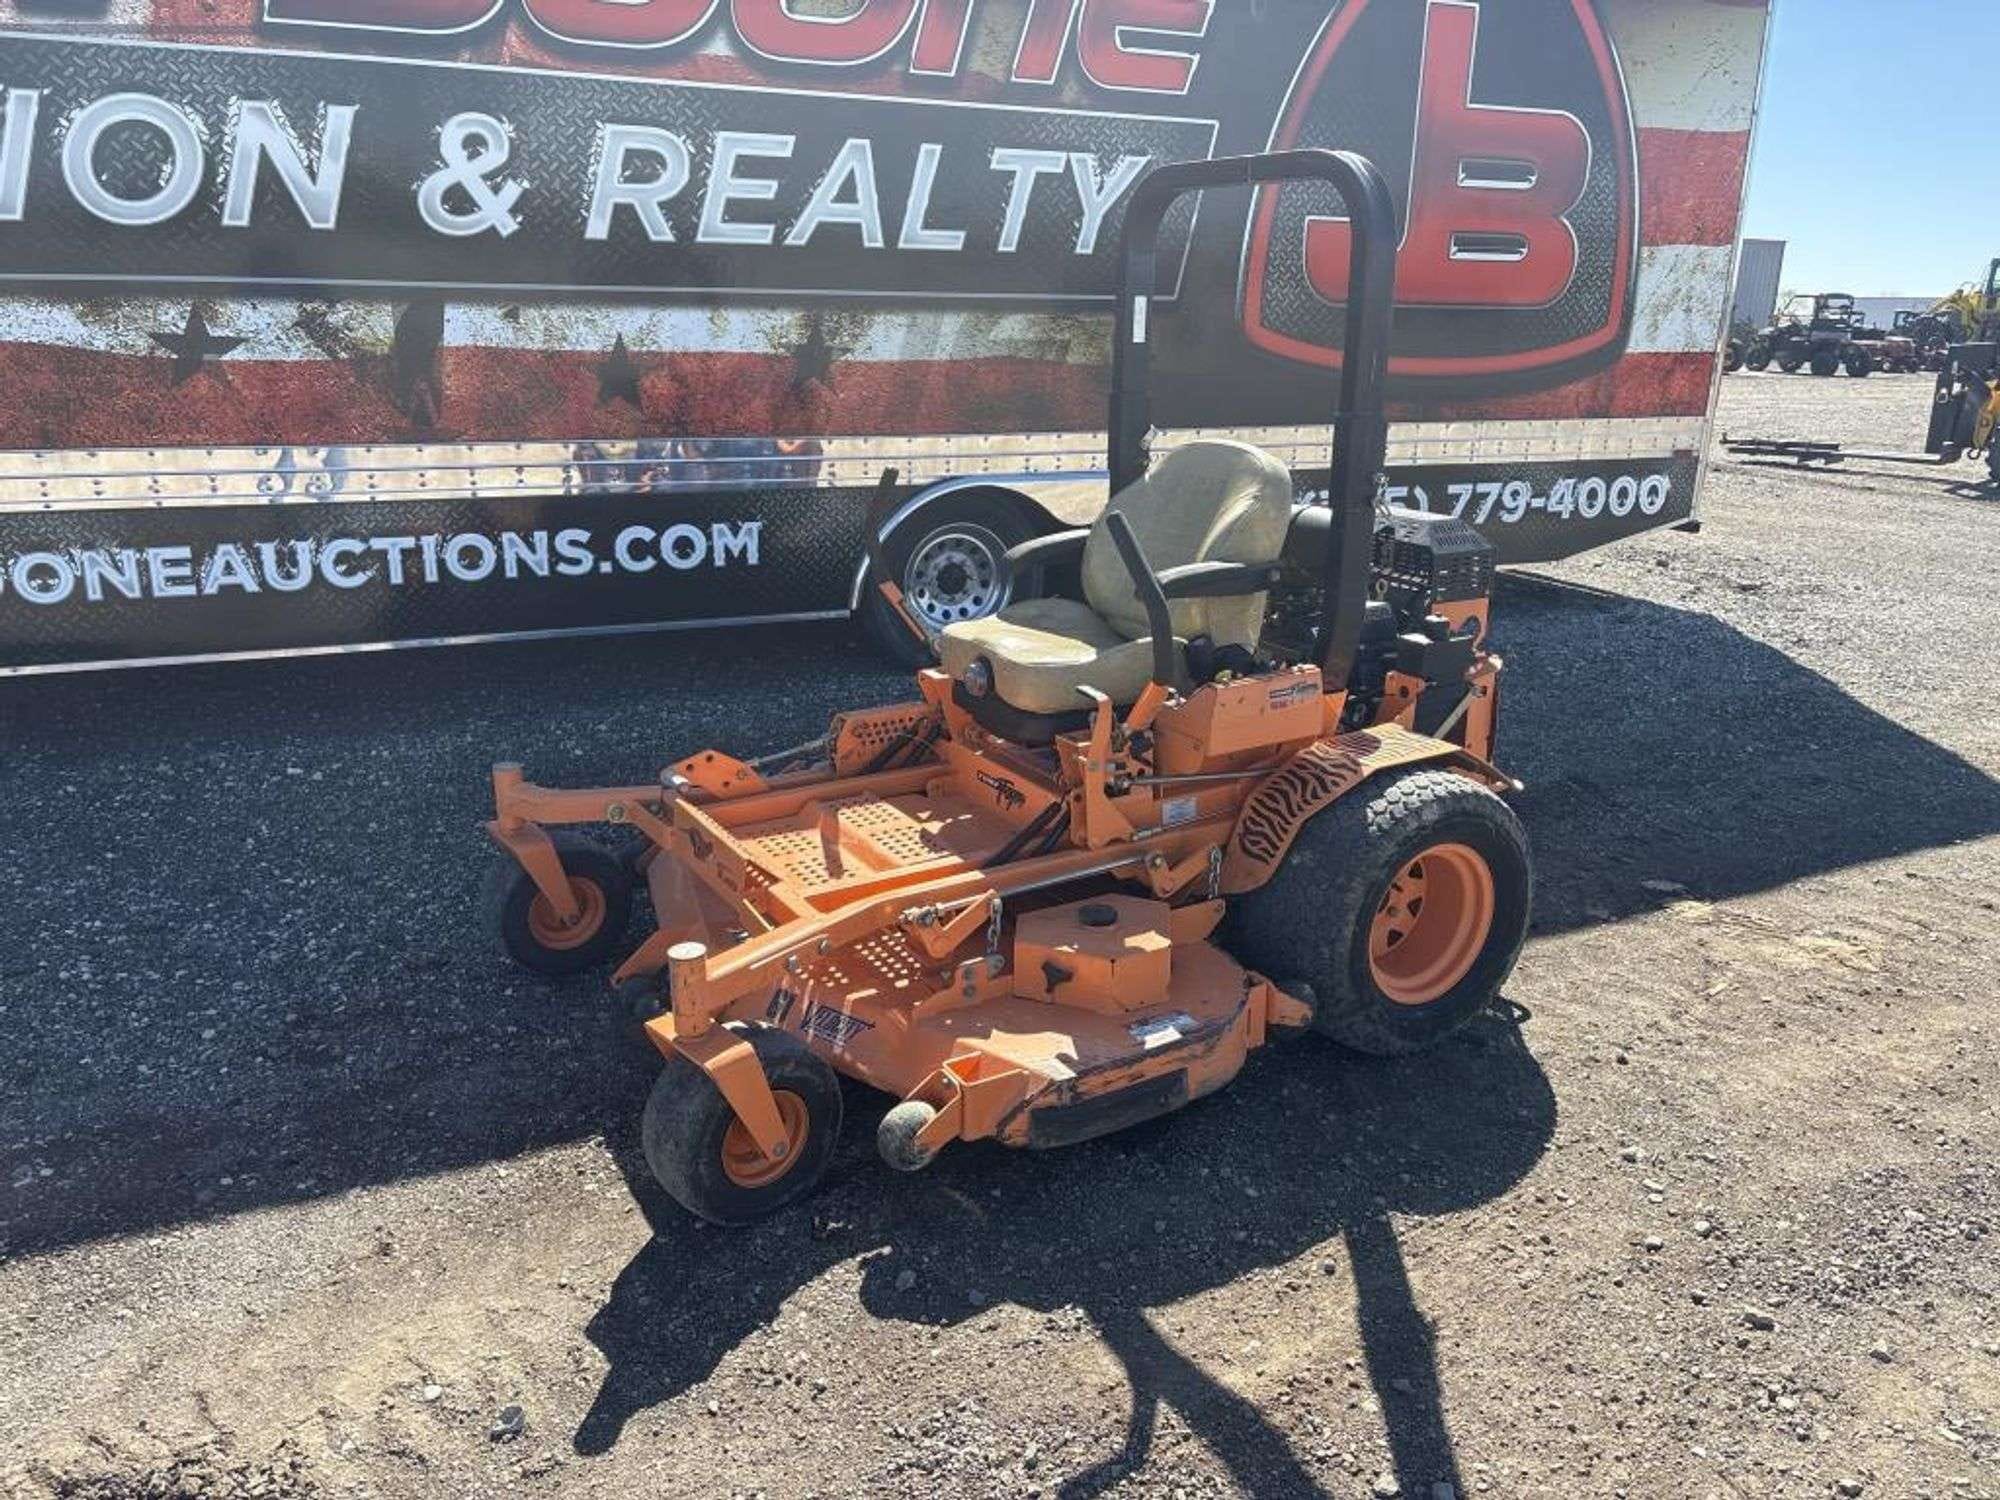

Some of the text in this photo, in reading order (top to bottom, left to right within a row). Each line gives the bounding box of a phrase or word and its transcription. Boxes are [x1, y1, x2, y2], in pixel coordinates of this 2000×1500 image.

[417, 112, 529, 238] &
[585, 123, 1151, 254] REALTY
[1447, 474, 1671, 524] 779-4000
[0, 522, 762, 605] ONEAUCTIONS.COM
